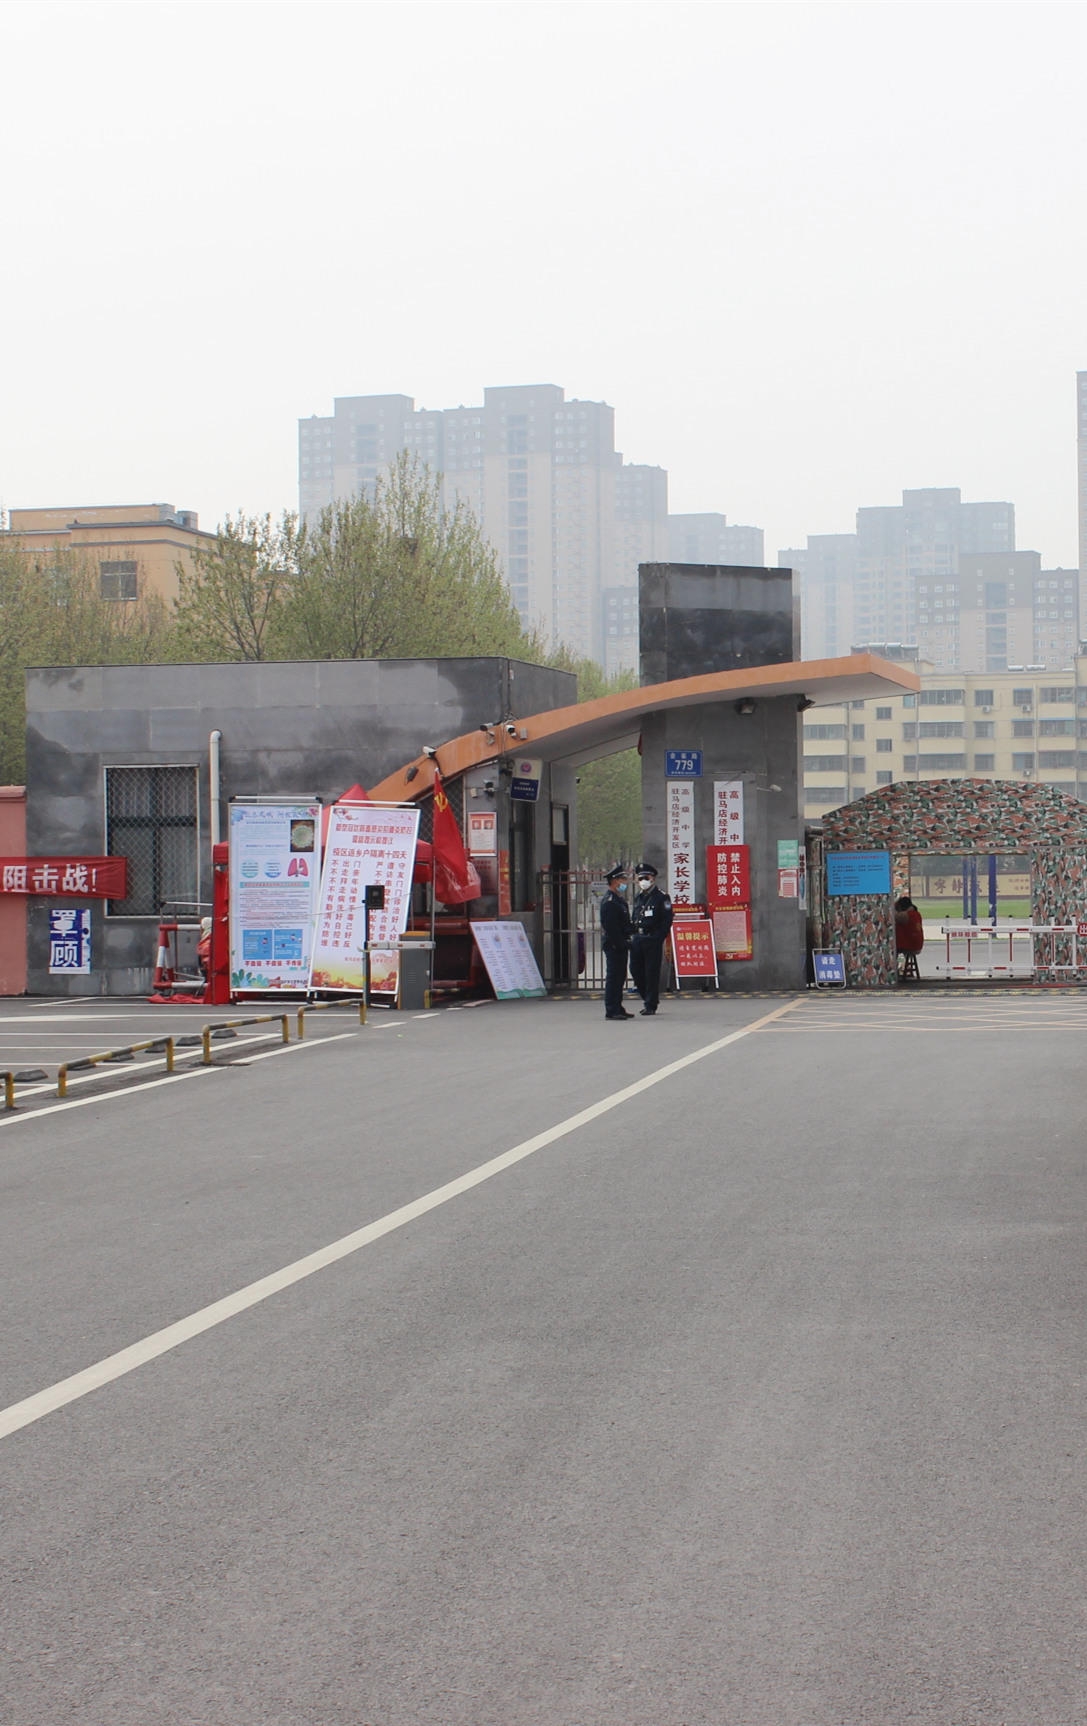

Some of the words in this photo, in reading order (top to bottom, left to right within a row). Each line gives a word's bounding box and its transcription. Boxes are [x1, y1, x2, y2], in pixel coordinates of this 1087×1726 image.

[674, 760, 694, 770] 779
[672, 788, 680, 849] 驻马店经济开发区
[3, 864, 97, 893] 阻击战!
[673, 852, 691, 905] 家长学校
[717, 853, 729, 897] 防控肺炎
[730, 852, 742, 897] 禁止入内
[819, 970, 841, 979] 消毒垫
